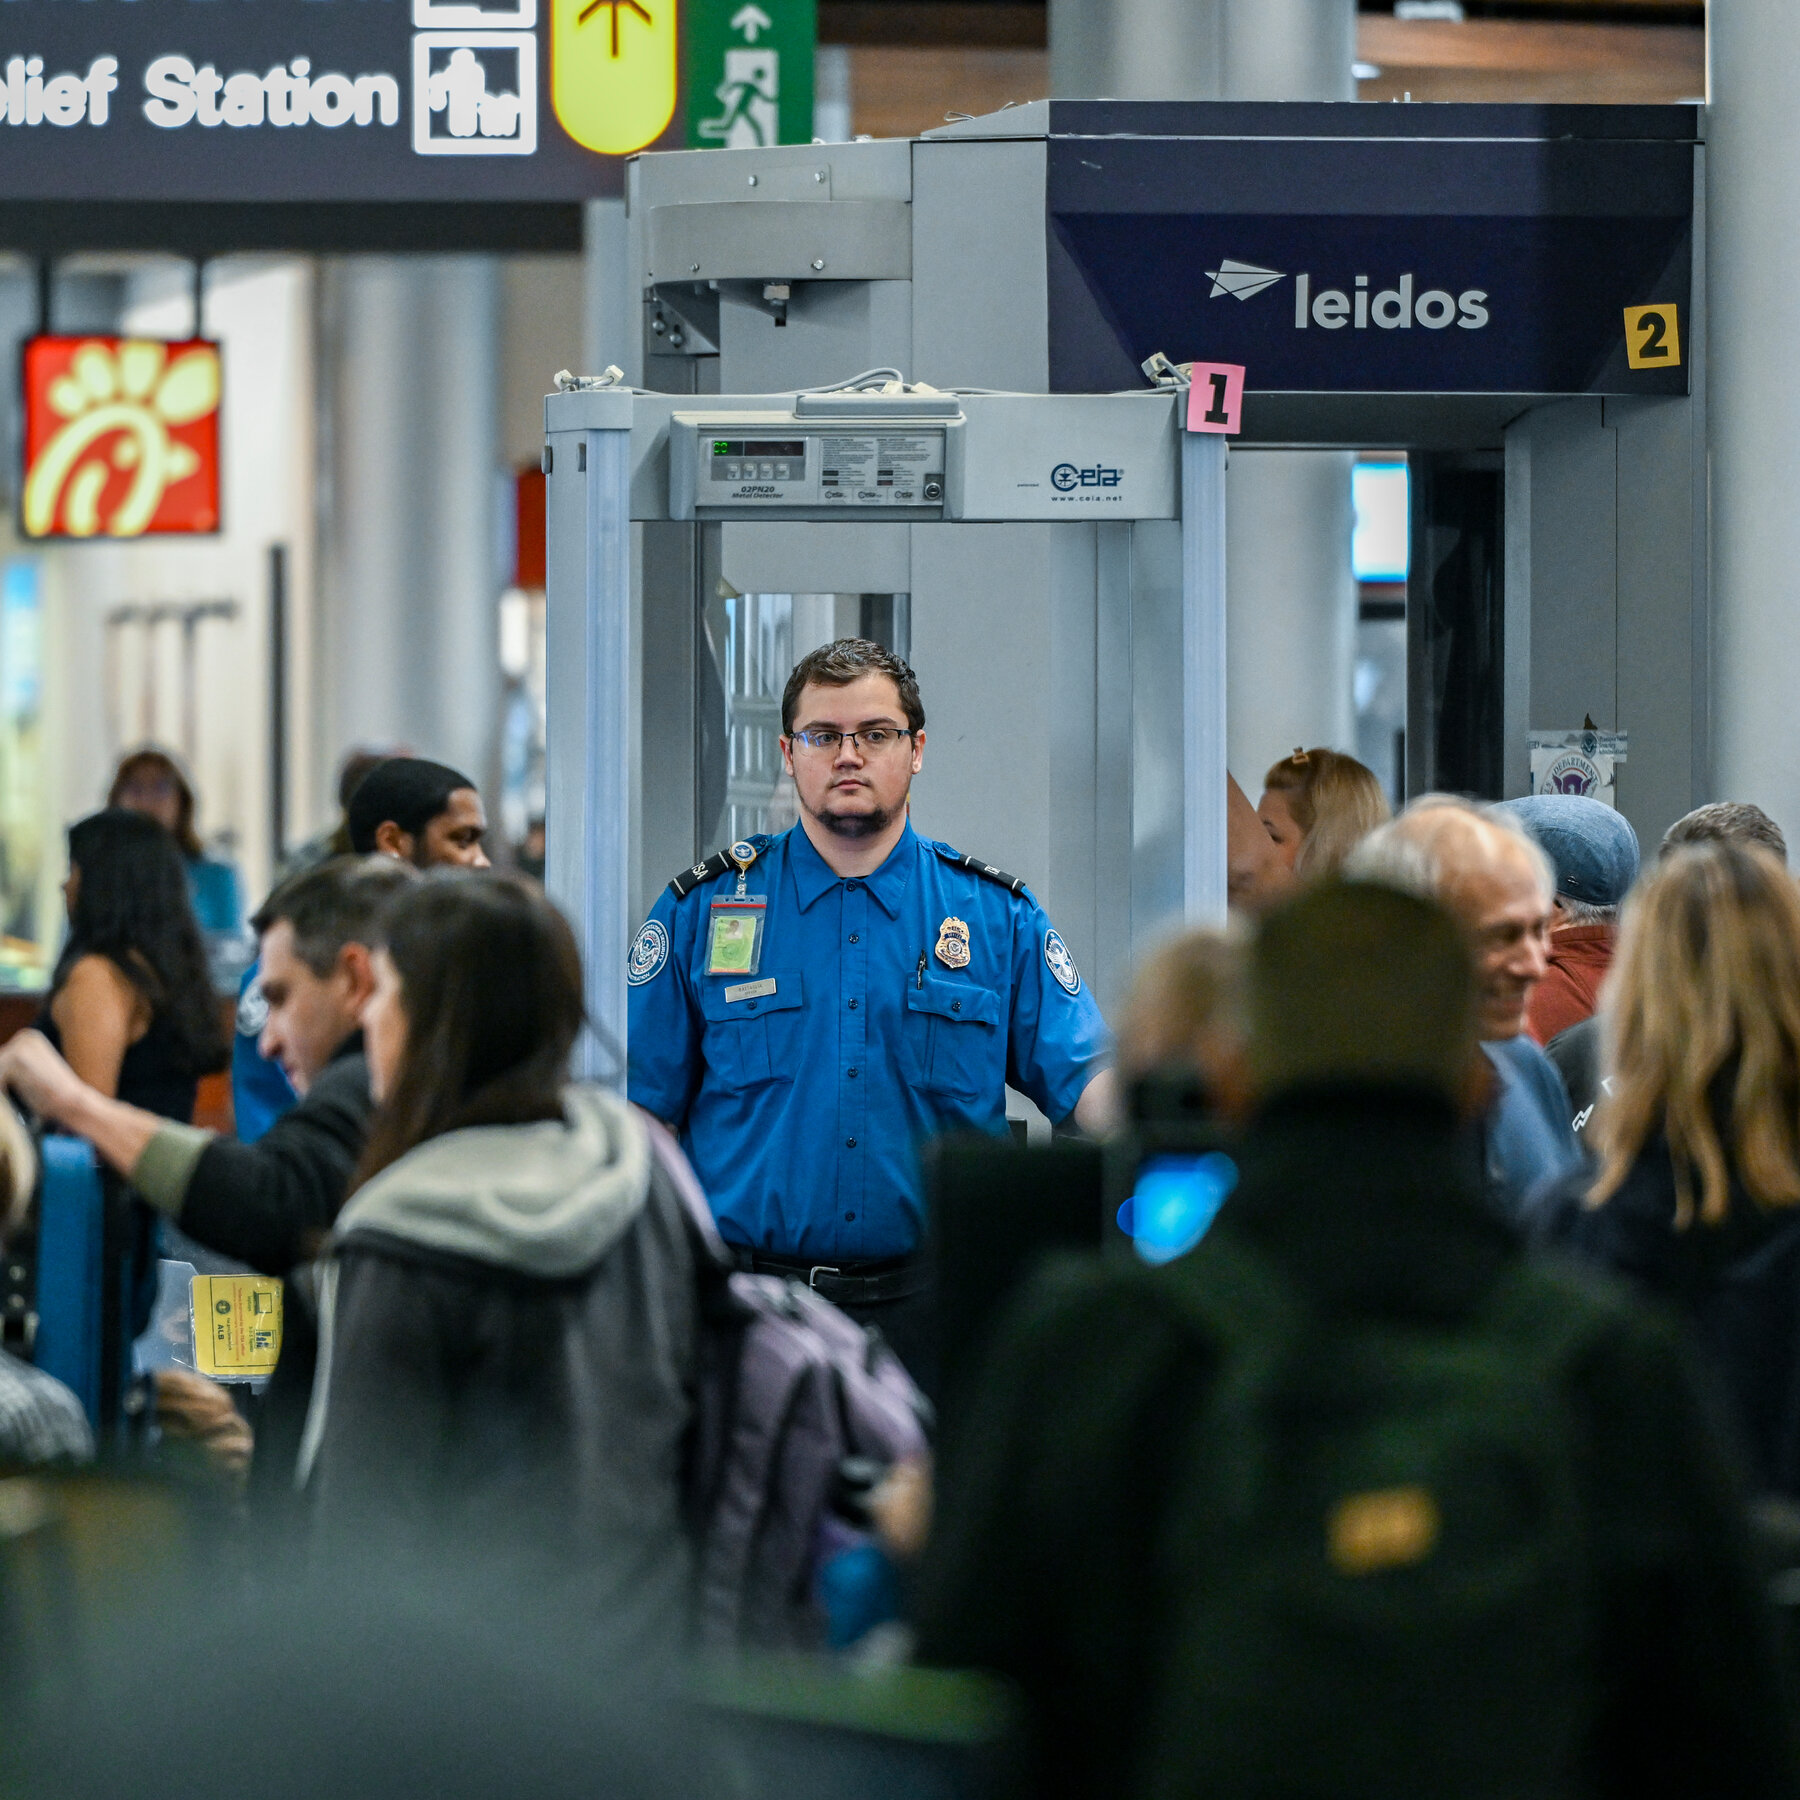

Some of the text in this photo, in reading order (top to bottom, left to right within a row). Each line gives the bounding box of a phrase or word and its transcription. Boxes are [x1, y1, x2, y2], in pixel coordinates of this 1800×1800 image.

[0, 55, 400, 128] lief Station
[1295, 273, 1489, 329] leidos
[1637, 312, 1668, 358] 2
[1204, 373, 1229, 424] 1
[1552, 757, 1598, 782] DEPARTMENT
